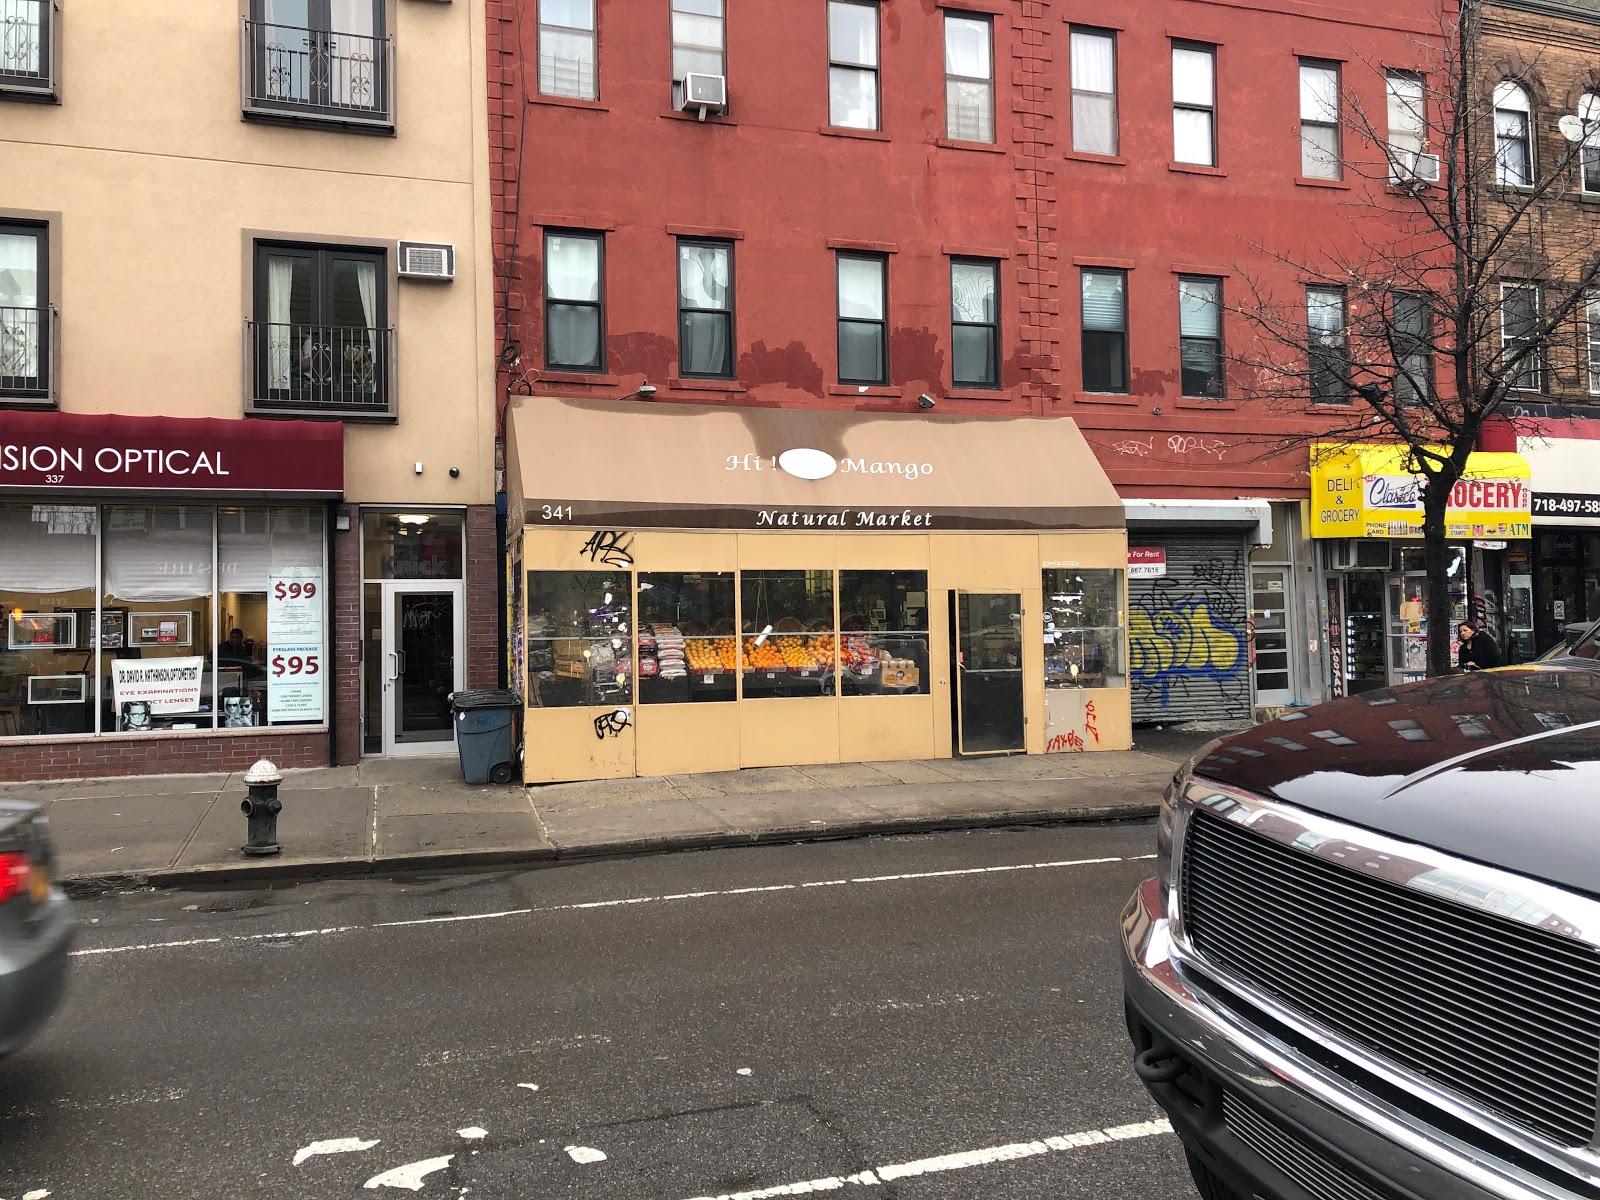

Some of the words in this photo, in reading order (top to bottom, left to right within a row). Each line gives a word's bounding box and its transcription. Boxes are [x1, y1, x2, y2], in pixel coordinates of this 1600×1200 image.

[95, 448, 230, 475] OPTICAL
[725, 453, 763, 471] Hi
[840, 458, 933, 480] Mango
[45, 474, 64, 484] 337
[1327, 478, 1353, 492] DELI
[1335, 495, 1344, 505] &
[1446, 481, 1522, 509] OCERY
[541, 504, 573, 521] 341
[1534, 498, 1600, 514] 718-497-58
[756, 510, 850, 526] Natural
[855, 509, 932, 527] Market
[1321, 509, 1359, 523] GROCERY
[1509, 524, 1529, 535] ATM
[1128, 566, 1160, 574] .667.7616
[275, 581, 316, 601] $99
[272, 655, 319, 678] $95
[127, 670, 139, 683] DAVID
[137, 687, 198, 695] EXAMINATIONS
